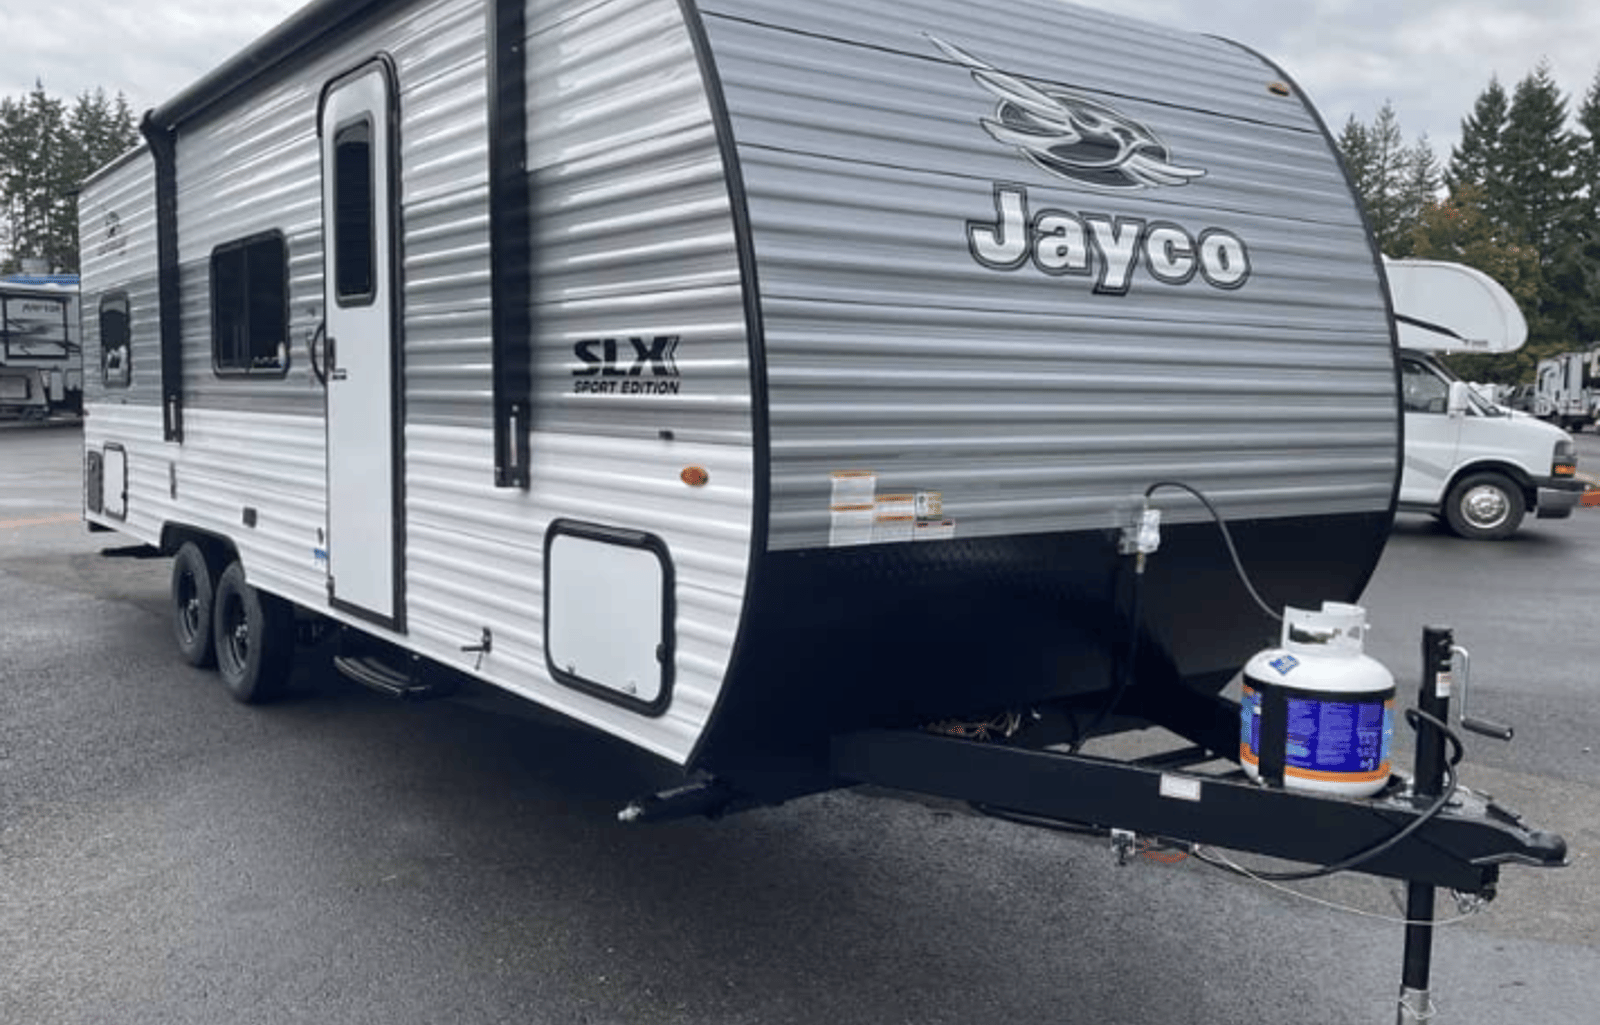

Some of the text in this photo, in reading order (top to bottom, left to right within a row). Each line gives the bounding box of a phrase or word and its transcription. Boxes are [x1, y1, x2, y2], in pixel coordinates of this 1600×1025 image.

[966, 183, 1250, 296] Jayco
[572, 335, 680, 376] SLX
[573, 380, 680, 395] SPORT EDITION
